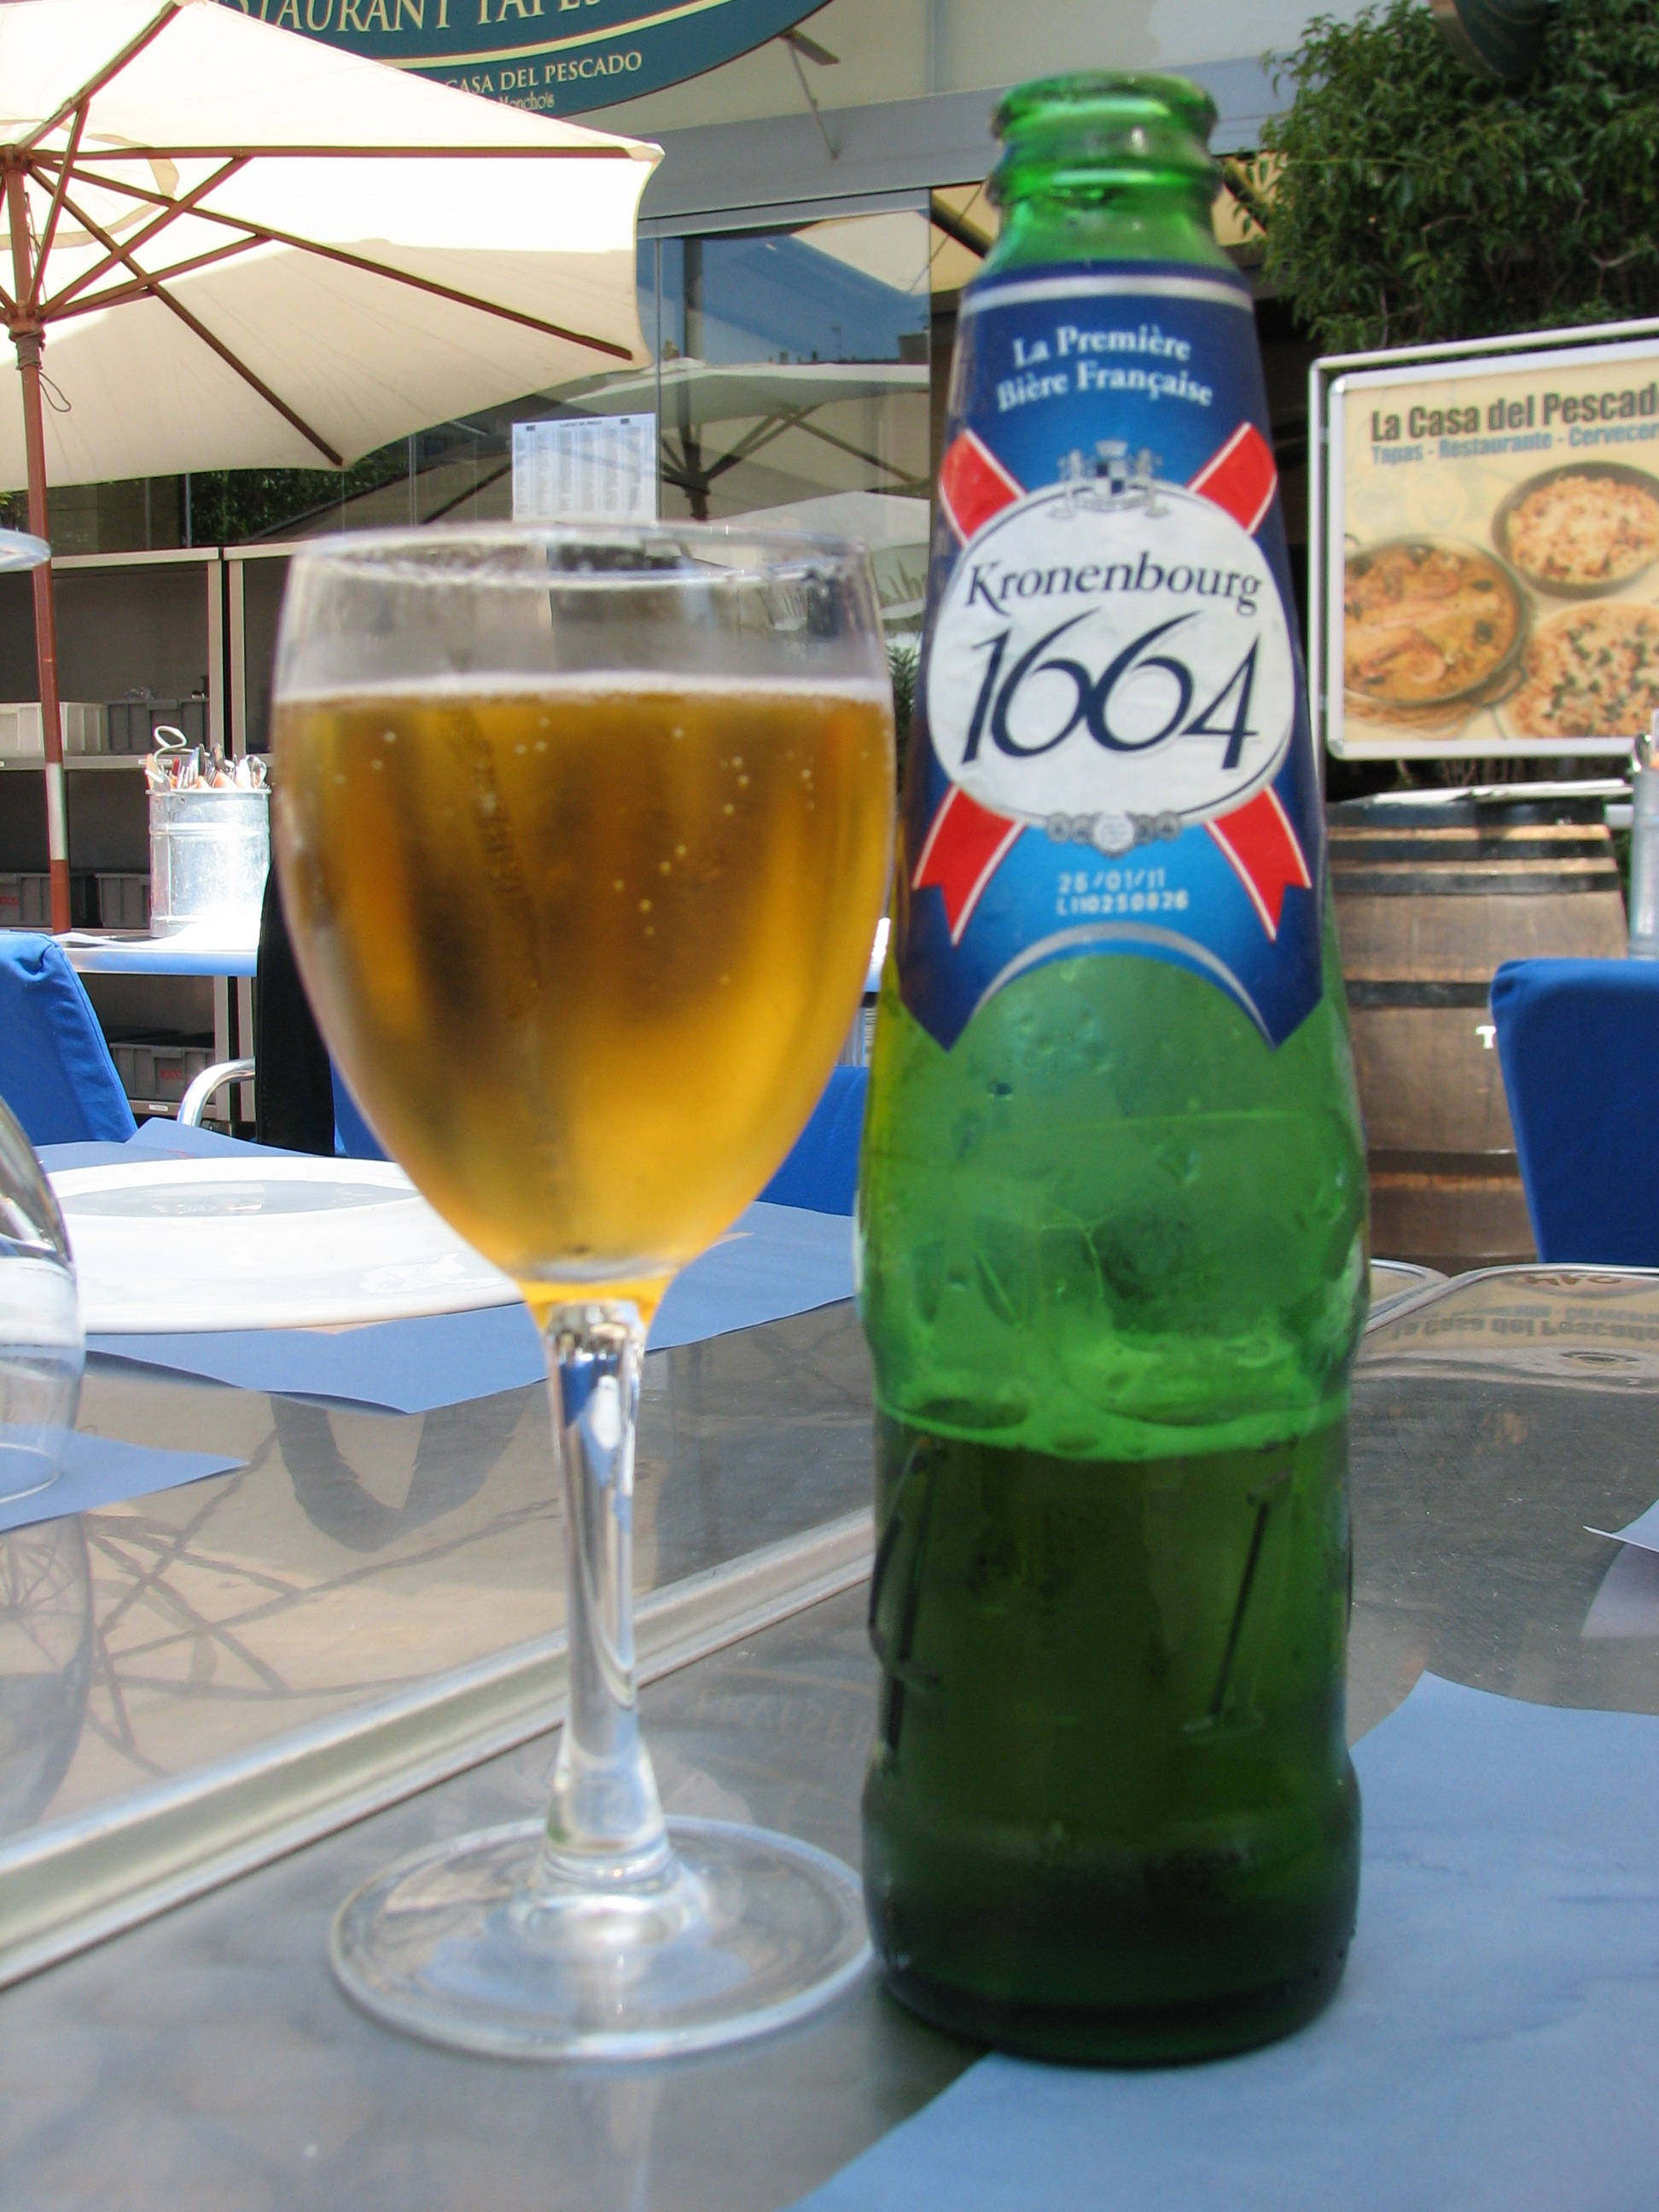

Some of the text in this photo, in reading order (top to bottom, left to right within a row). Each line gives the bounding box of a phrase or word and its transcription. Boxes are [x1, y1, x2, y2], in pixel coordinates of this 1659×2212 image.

[500, 68, 540, 91] DEL
[544, 51, 643, 84] PESCADO
[1013, 324, 1191, 368] La Première
[995, 359, 1213, 413] Bière Française
[1371, 410, 1400, 442] La
[1409, 405, 1481, 439] Casa
[1487, 395, 1535, 430] del
[1372, 443, 1423, 465] Tapas
[1439, 431, 1553, 459] Restaurante
[965, 551, 1263, 617] Kronenbourg
[961, 606, 1261, 770] 1664
